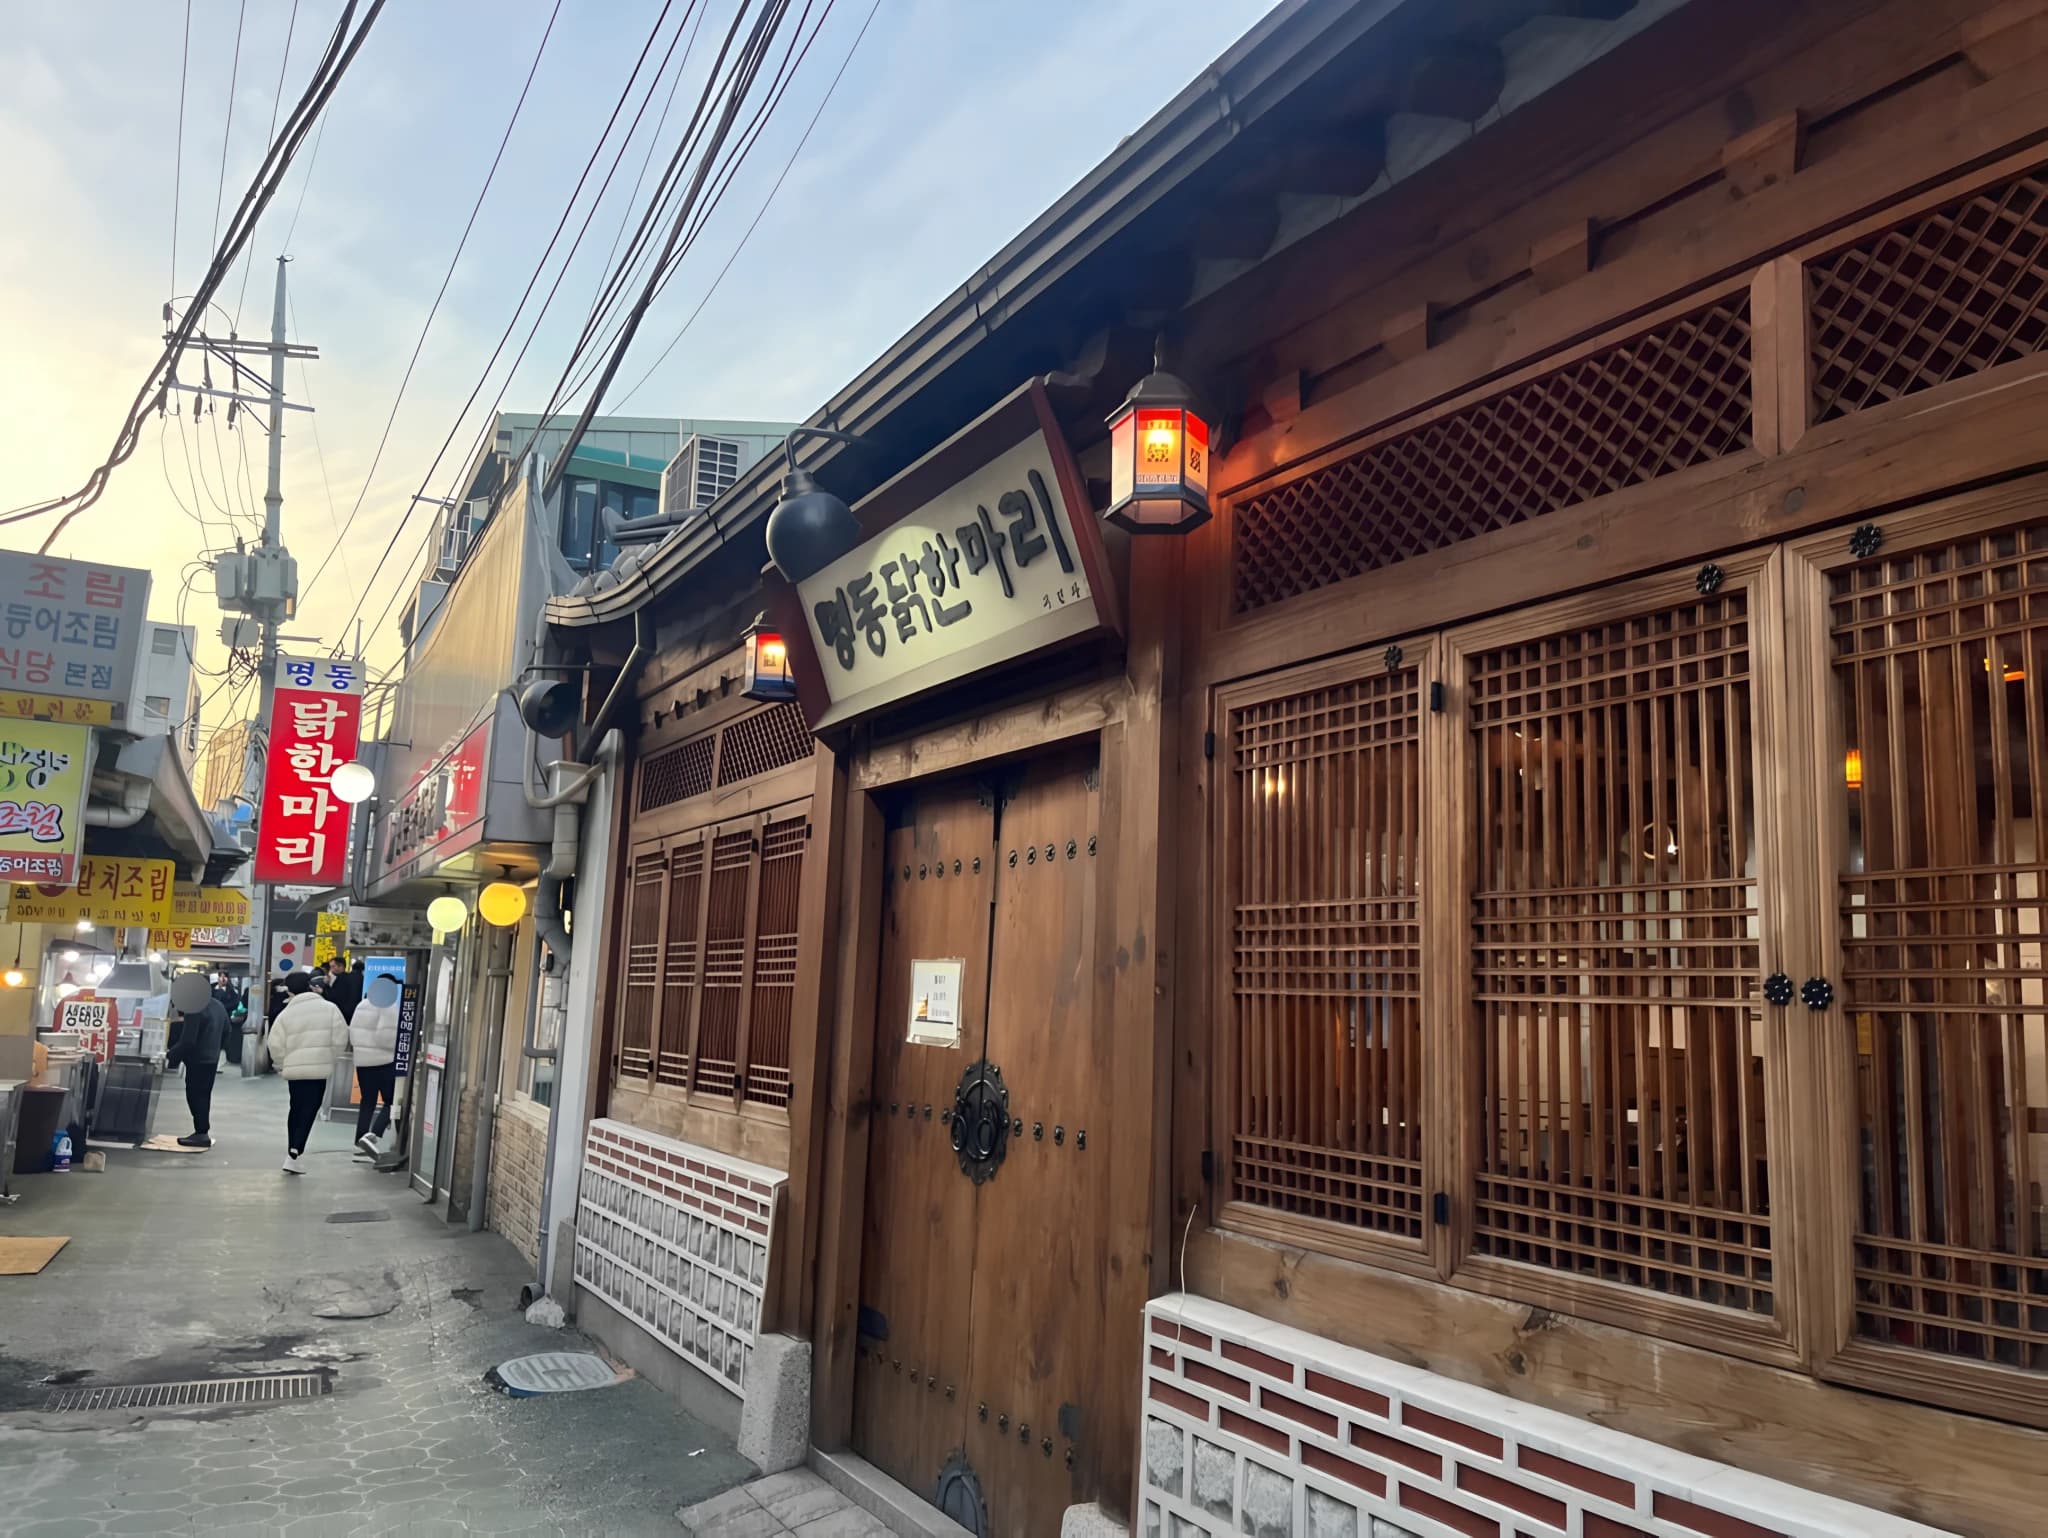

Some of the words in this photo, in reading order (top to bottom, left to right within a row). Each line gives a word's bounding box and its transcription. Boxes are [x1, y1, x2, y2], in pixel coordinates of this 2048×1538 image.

[0, 602, 120, 650] 등어조림
[64, 661, 113, 689] 본점
[285, 660, 358, 691] 명동
[274, 697, 349, 876] 닭한마리
